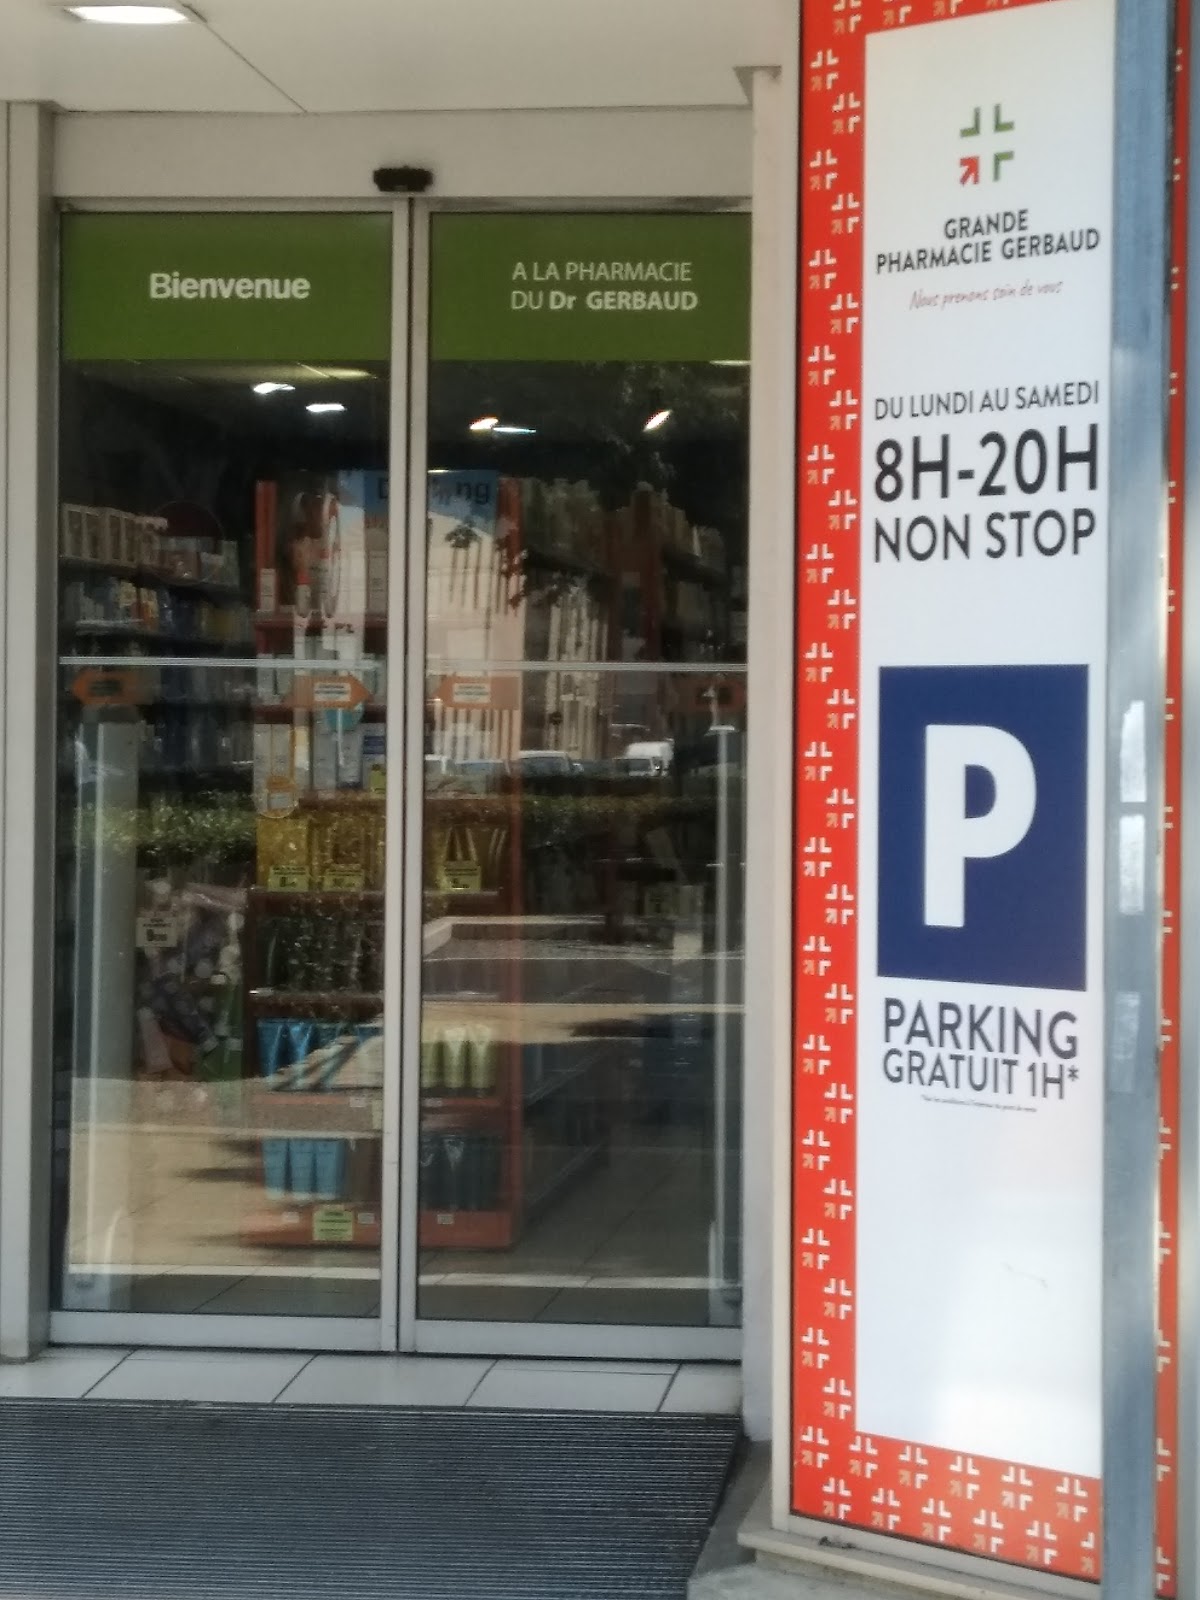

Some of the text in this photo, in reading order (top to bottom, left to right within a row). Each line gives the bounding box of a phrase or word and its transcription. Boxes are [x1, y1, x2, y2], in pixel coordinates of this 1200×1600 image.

[943, 208, 1029, 240] GRANDE
[511, 261, 693, 282] A LA PHARMACIE
[876, 228, 1101, 275] PHARMACIE GERBAUD
[150, 271, 311, 299] Bienvenue
[511, 290, 699, 311] DU Dr GERBAUD
[909, 279, 1064, 311] Nous prenons soin de vous
[875, 380, 1099, 420] DU LUNDI AU SAMEDI
[875, 423, 1099, 502] 8H-20H
[875, 508, 1096, 563] NON STOP
[924, 724, 1037, 928] P
[884, 997, 1078, 1060] PARKING
[883, 1047, 1019, 1094] GRATUIT
